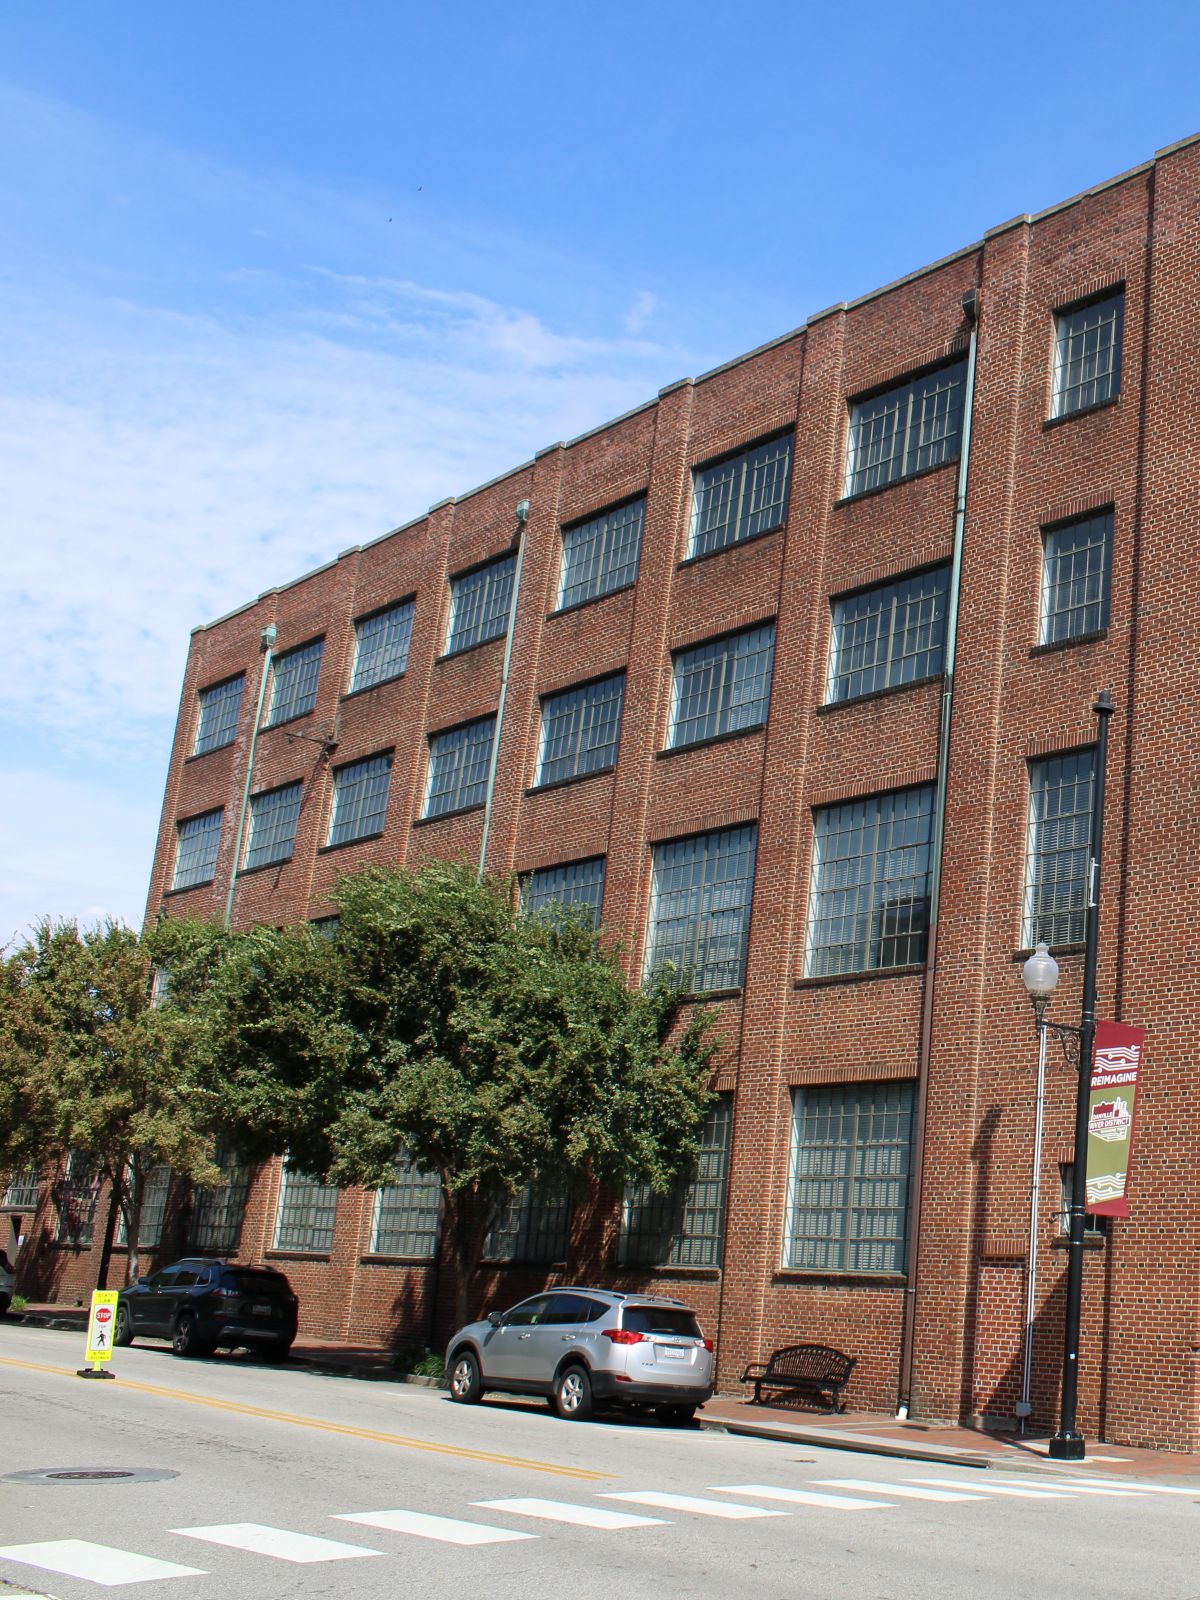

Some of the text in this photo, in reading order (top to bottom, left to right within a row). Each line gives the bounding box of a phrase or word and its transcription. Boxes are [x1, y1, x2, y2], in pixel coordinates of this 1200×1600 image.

[1091, 1072, 1137, 1087] REIMAGINE
[1089, 1117, 1128, 1129] RIVER DISTRICT
